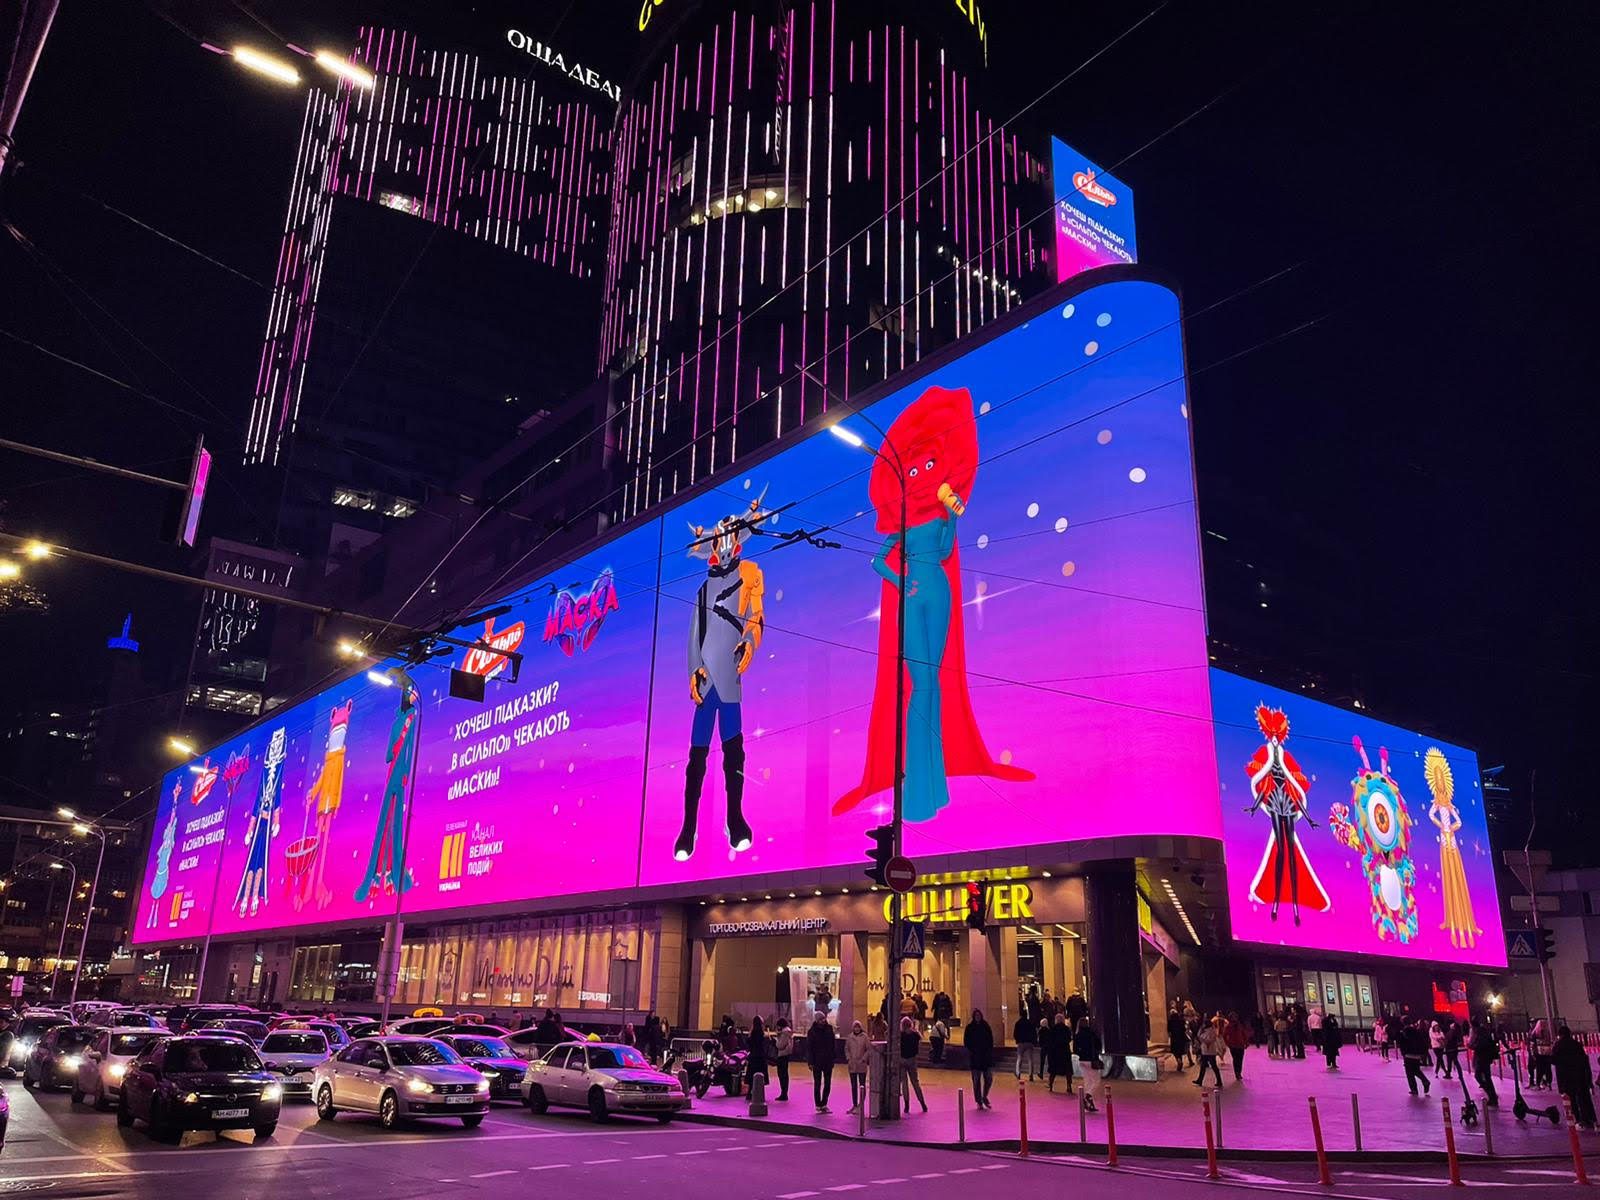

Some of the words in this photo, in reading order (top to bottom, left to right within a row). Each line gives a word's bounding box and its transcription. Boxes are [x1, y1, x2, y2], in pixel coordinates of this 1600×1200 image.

[1060, 200, 1087, 222] ХОЧЕШ
[1088, 216, 1125, 247] ПІДКАЗКИ?
[1061, 212, 1066, 222] В
[543, 584, 619, 642] МАСКА
[454, 710, 492, 741] ХОЧЕШ
[494, 681, 559, 725] ПІДКАЗКИ?
[451, 753, 457, 771] В
[460, 734, 510, 768] «СІЛЬПО»
[514, 710, 570, 746] ЧЕКАЮТЬ
[448, 766, 500, 800] «МАСКИ»!
[469, 840, 503, 858] ВЕЛИКИХ
[709, 917, 800, 933] ТОРГОВО-РОЗВАЖАЛЬНИЙ
[801, 918, 826, 930] ЦЕНТР
